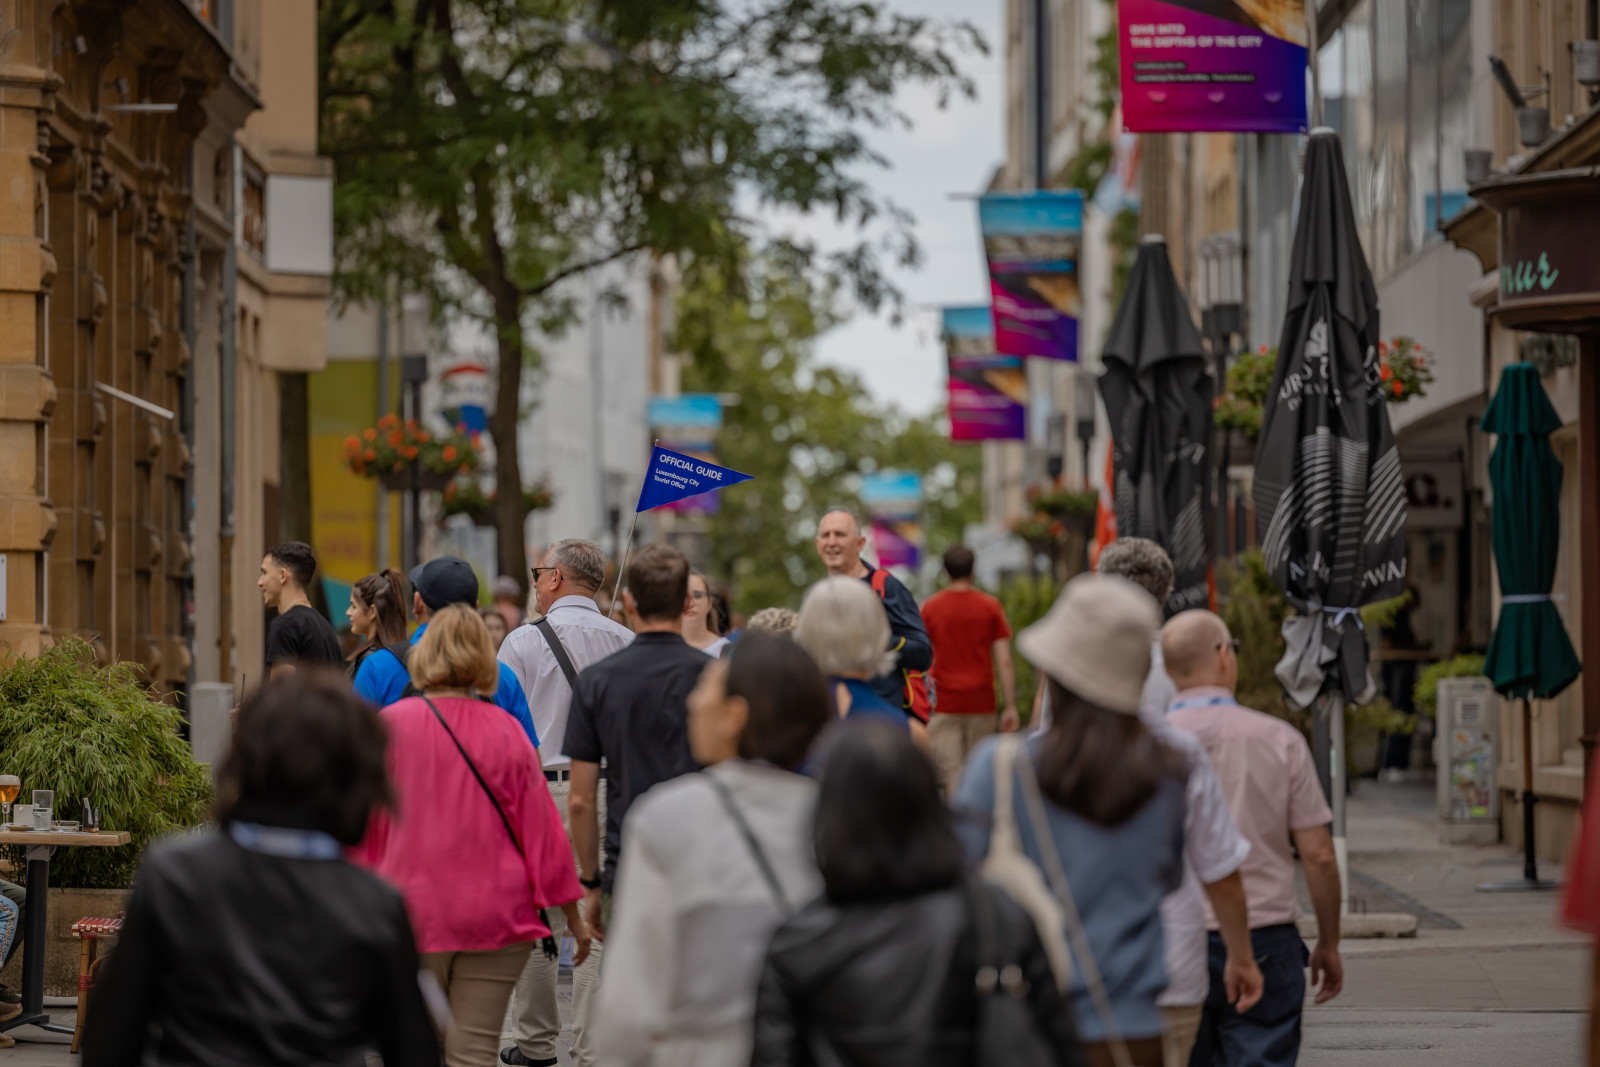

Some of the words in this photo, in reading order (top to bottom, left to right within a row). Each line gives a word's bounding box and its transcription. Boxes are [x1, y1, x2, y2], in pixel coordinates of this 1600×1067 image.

[1129, 24, 1155, 35] DIVE
[1156, 23, 1186, 35] INTO
[1129, 36, 1152, 48] THE
[1153, 36, 1197, 48] DEPTHS
[1197, 35, 1214, 48] OF
[1214, 35, 1237, 48] THE
[1237, 35, 1263, 48] CITY
[659, 454, 694, 472] OFFICIAL
[696, 466, 722, 480] GUIDE
[654, 475, 669, 484] Tourist
[670, 480, 685, 489] Office
[655, 468, 688, 483] Luxembourg
[689, 479, 699, 487] City
